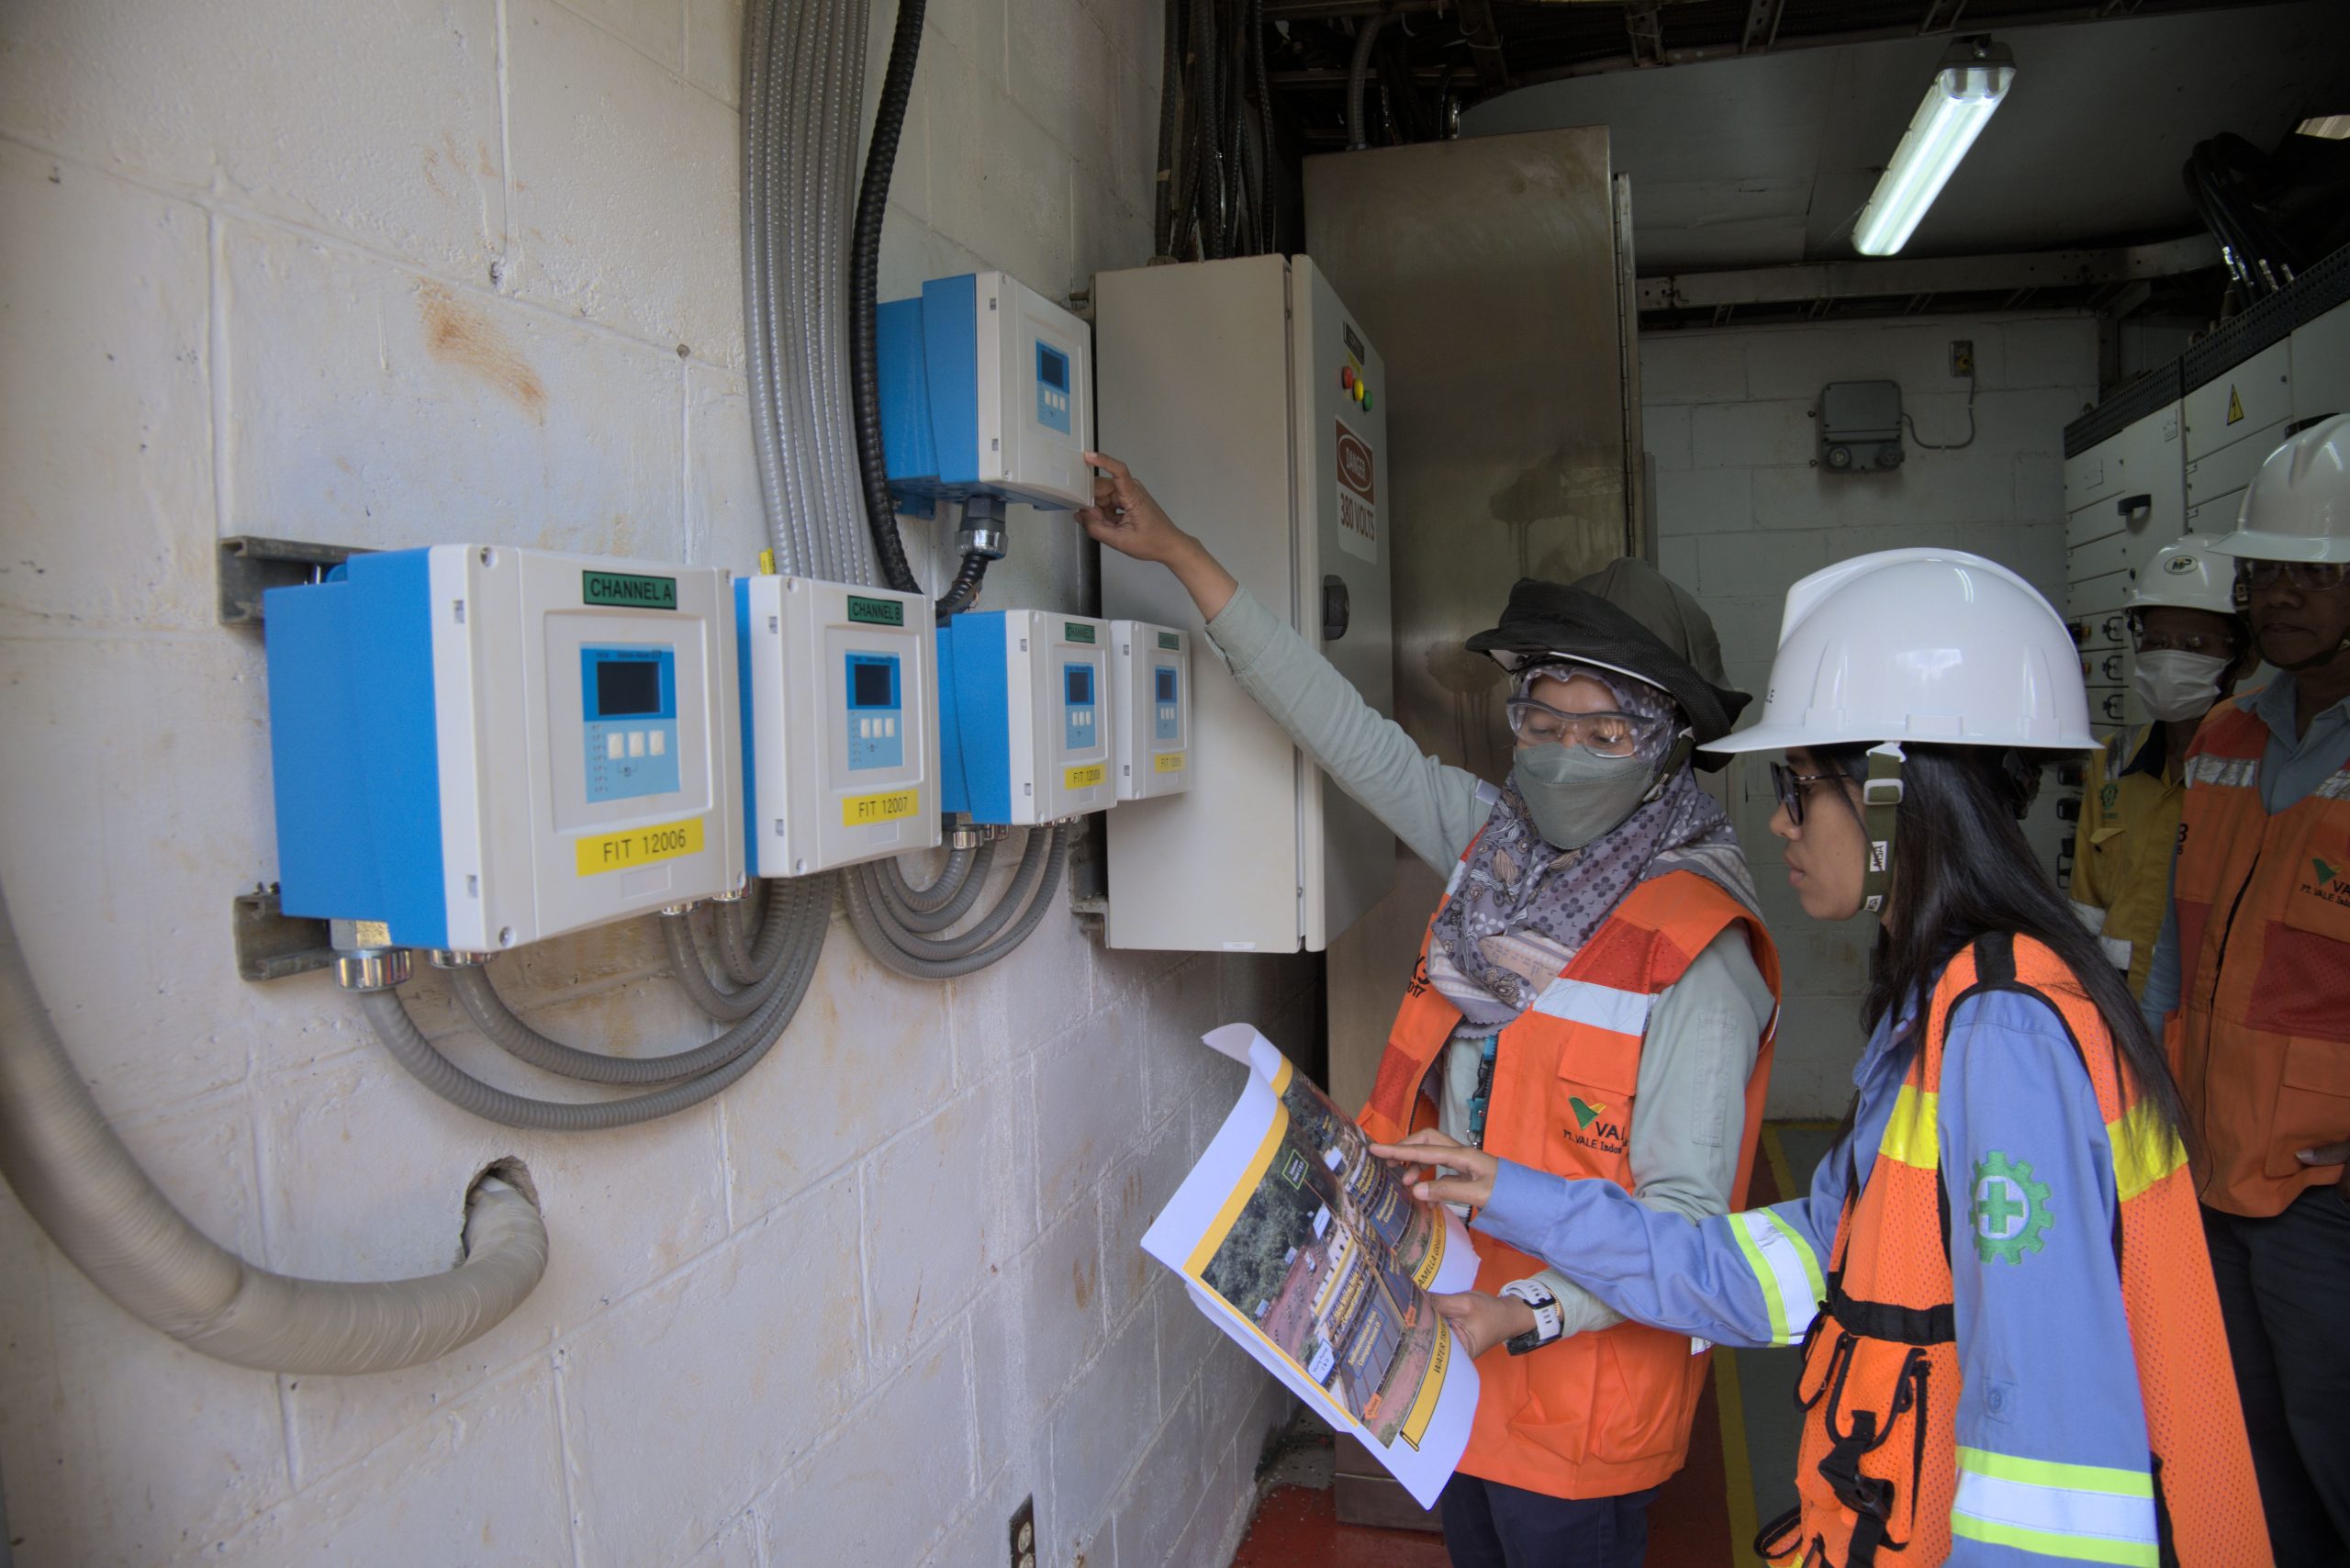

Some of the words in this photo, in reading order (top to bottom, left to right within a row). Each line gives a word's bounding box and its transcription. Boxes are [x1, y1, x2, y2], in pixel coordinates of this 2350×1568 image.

[1346, 447, 1366, 481] DANGER
[1340, 492, 1353, 529] 380
[1354, 501, 1374, 541] VOLTS
[590, 577, 660, 600] CHANNEL
[664, 584, 673, 601] A
[852, 603, 892, 621] CHANNEL
[894, 607, 901, 621] B
[1073, 771, 1083, 783] FIT
[858, 801, 878, 817] FIT
[882, 797, 908, 814] 12007
[603, 839, 632, 863] FIT
[643, 829, 687, 855] 12006
[1575, 1134, 1597, 1148] VALE
[1418, 1255, 1437, 1287] AMELLA
[1433, 1342, 1446, 1373] WATER
